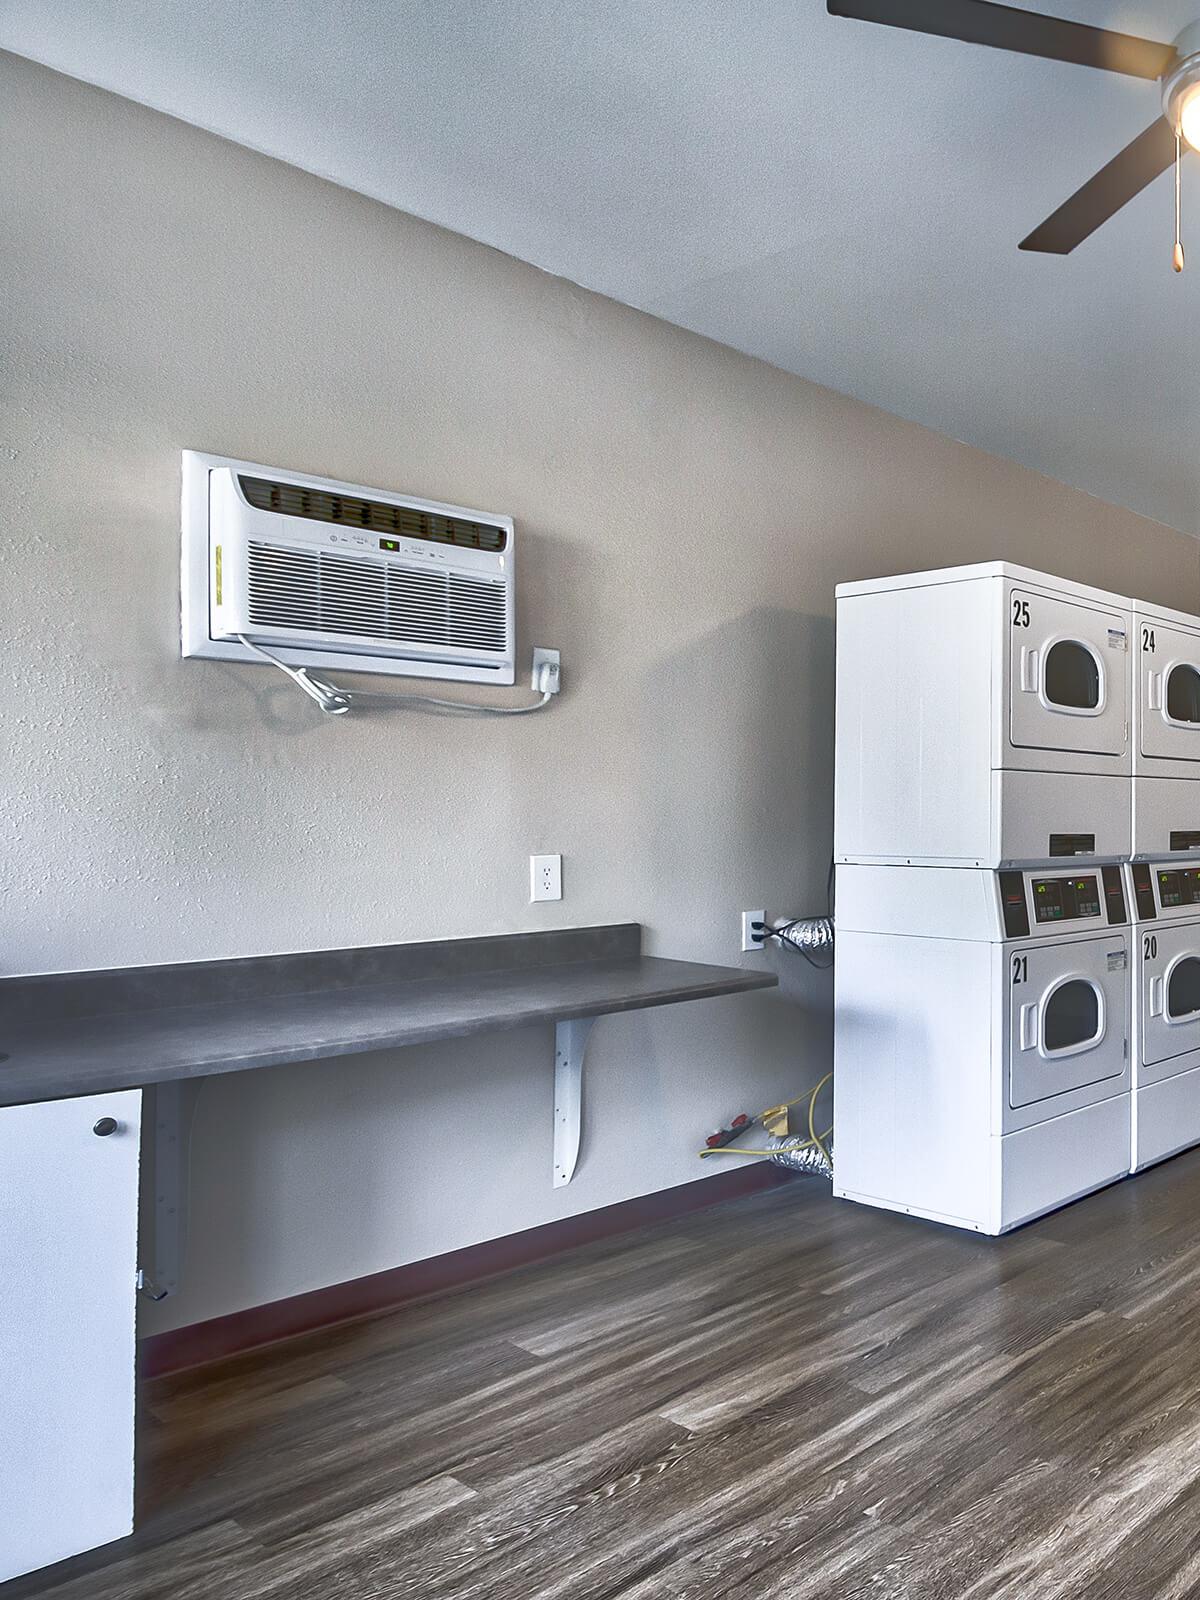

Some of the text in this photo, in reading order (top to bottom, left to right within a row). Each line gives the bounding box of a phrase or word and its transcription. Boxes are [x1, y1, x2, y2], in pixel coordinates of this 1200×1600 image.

[1013, 599, 1030, 628] 25
[1142, 628, 1156, 653] 24
[1143, 935, 1157, 961] 20
[1012, 955, 1028, 985] 21
